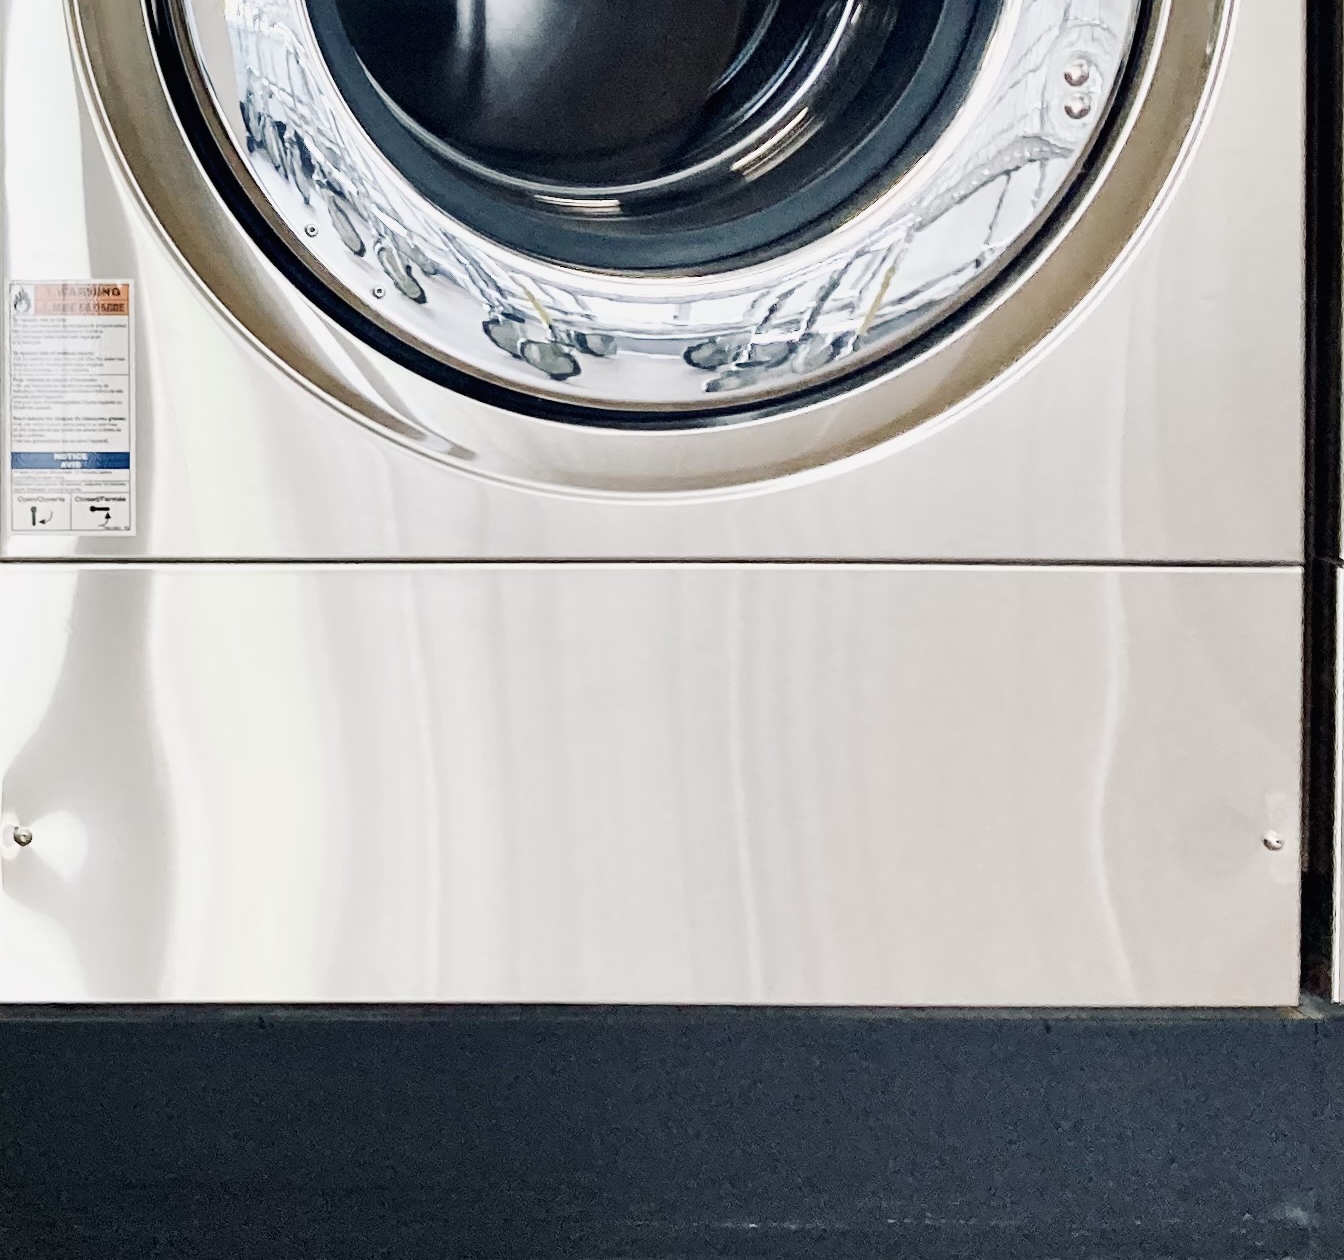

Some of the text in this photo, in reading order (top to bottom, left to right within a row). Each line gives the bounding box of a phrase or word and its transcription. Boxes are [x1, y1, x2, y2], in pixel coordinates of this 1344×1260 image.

[57, 287, 121, 297] WARNING
[53, 453, 88, 461] NOTICE
[60, 460, 82, 469] AVIS
